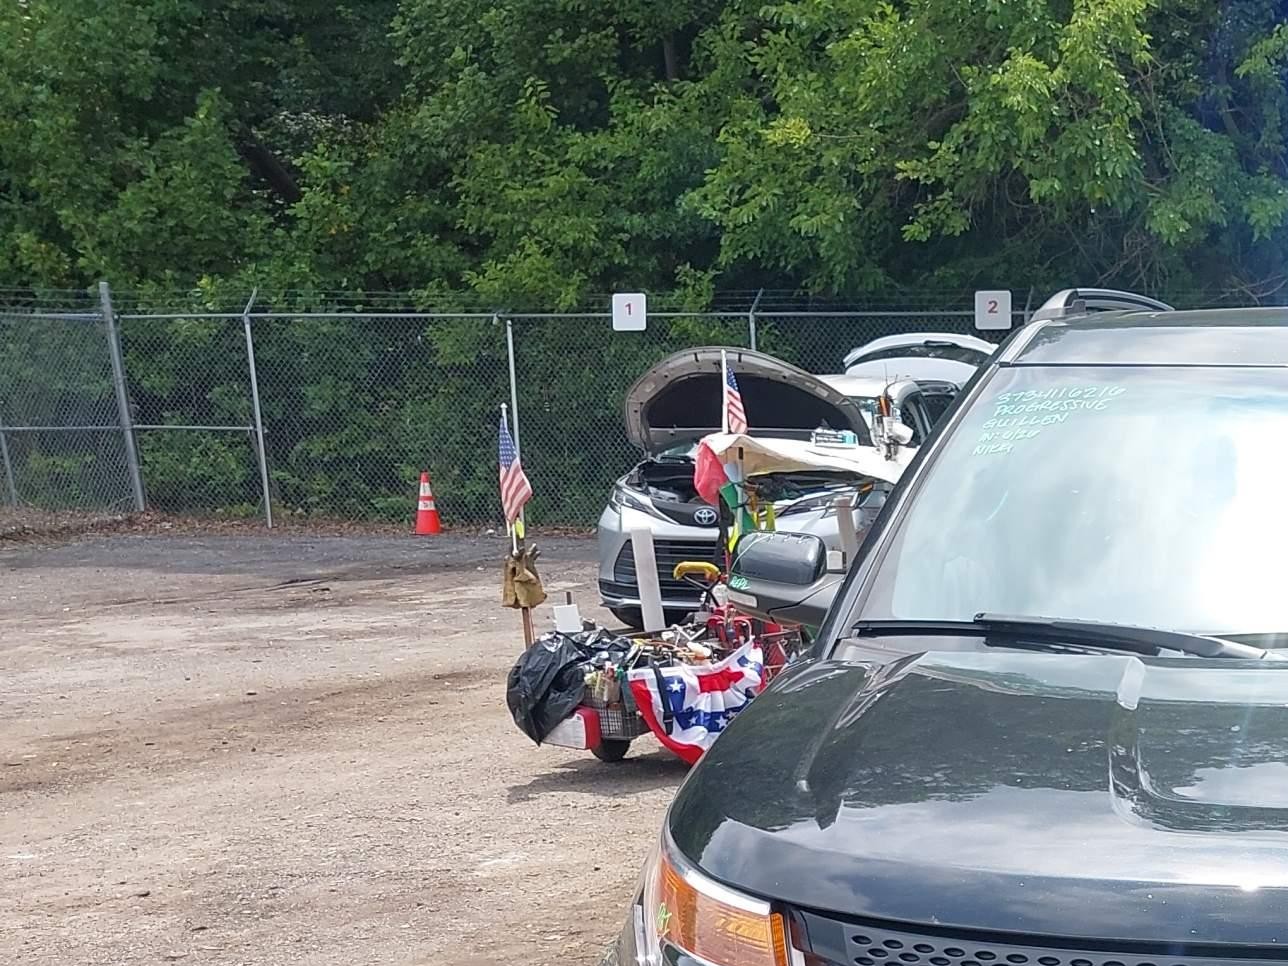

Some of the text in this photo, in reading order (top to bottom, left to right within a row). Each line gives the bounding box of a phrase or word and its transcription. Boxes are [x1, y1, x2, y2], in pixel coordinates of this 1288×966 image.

[625, 302, 632, 316] 1
[987, 300, 998, 314] 2
[994, 398, 1113, 417] PROGRESSIVE
